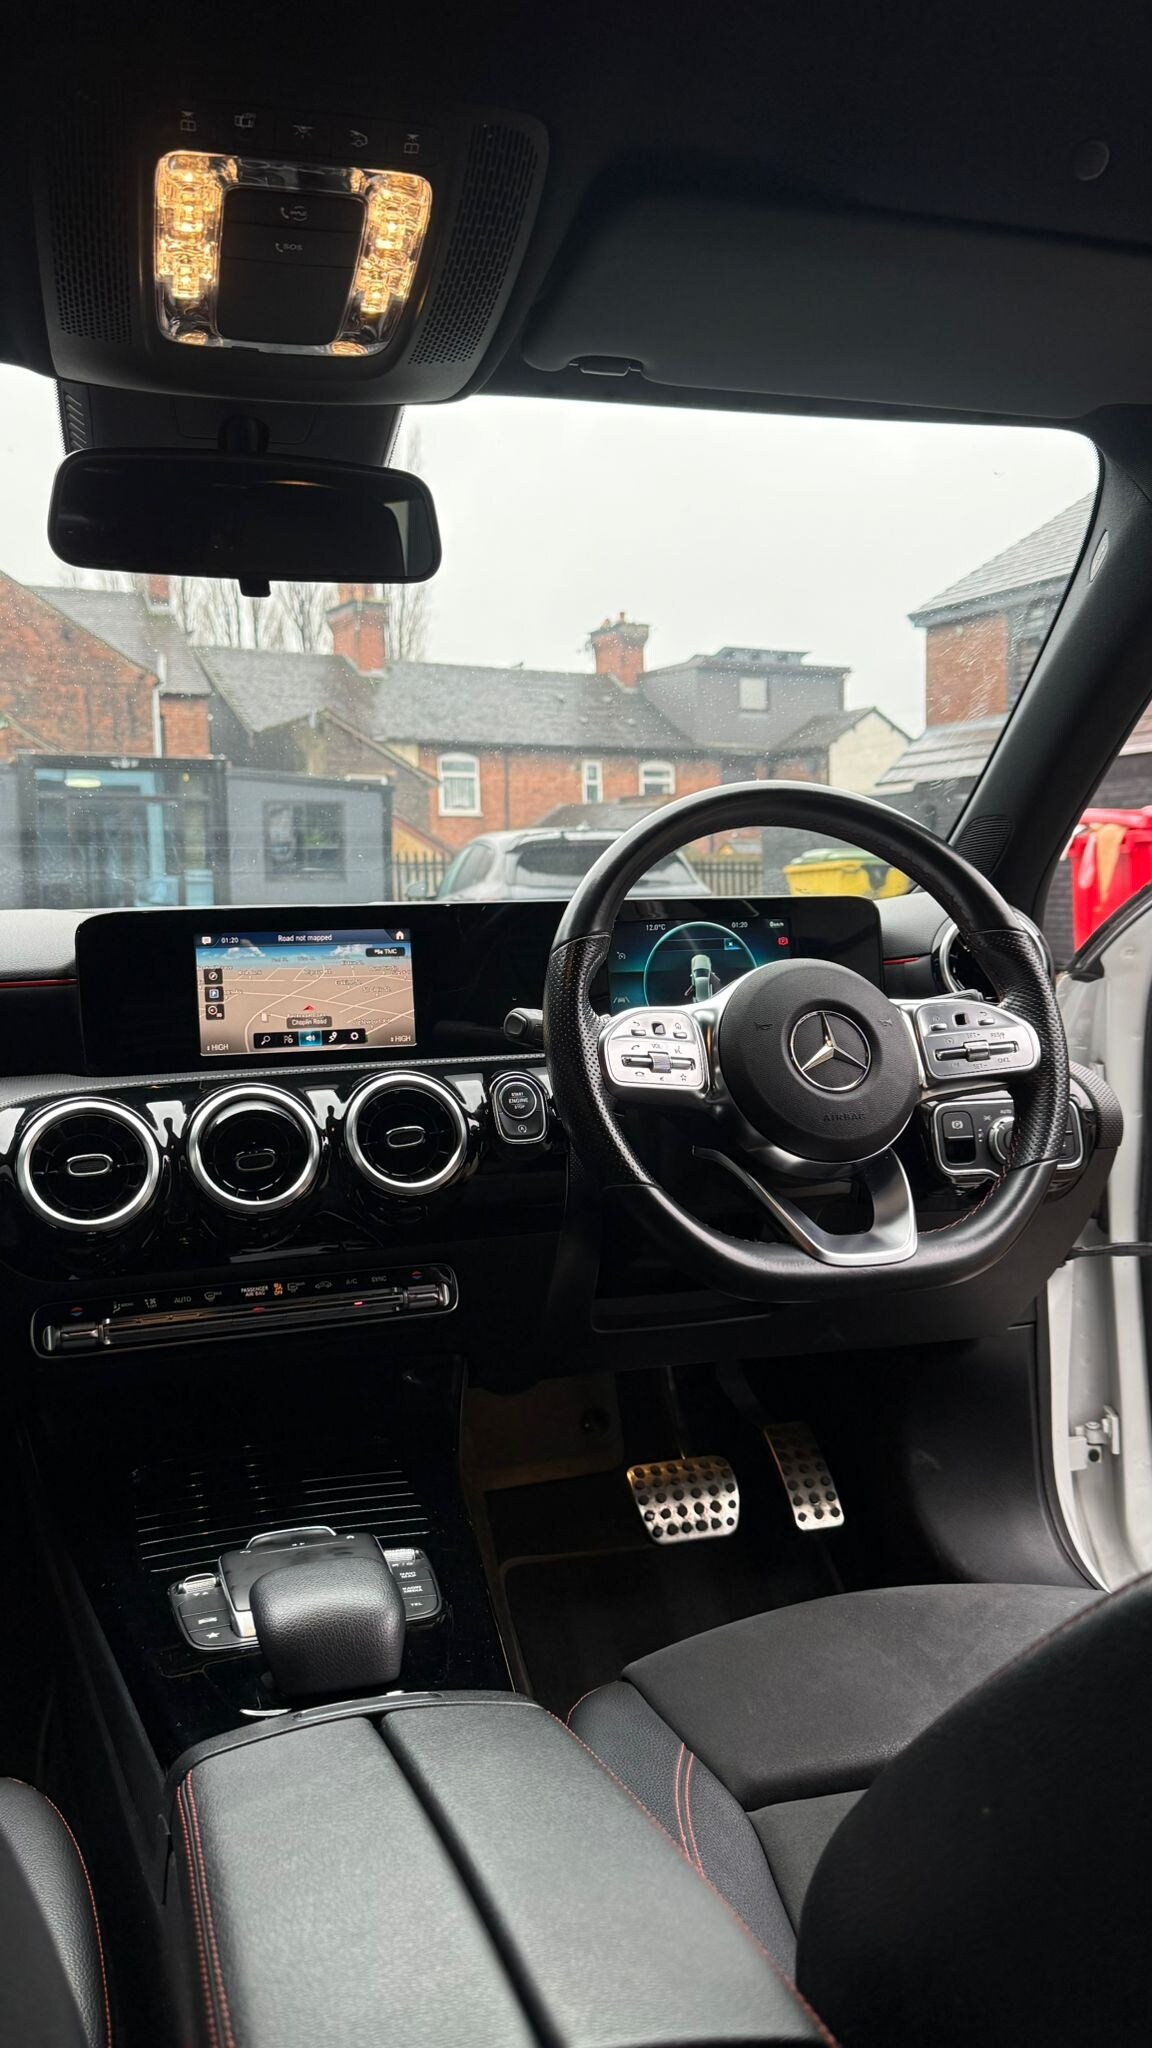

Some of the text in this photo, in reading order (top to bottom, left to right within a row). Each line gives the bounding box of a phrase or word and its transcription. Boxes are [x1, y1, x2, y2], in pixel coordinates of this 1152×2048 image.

[731, 921, 748, 929] 01:20
[221, 936, 239, 944] 01:20
[277, 933, 332, 942] Road not mapped
[394, 1035, 411, 1043] HIGH
[211, 1043, 229, 1051] HIGH
[823, 1112, 865, 1122] AIRBAG
